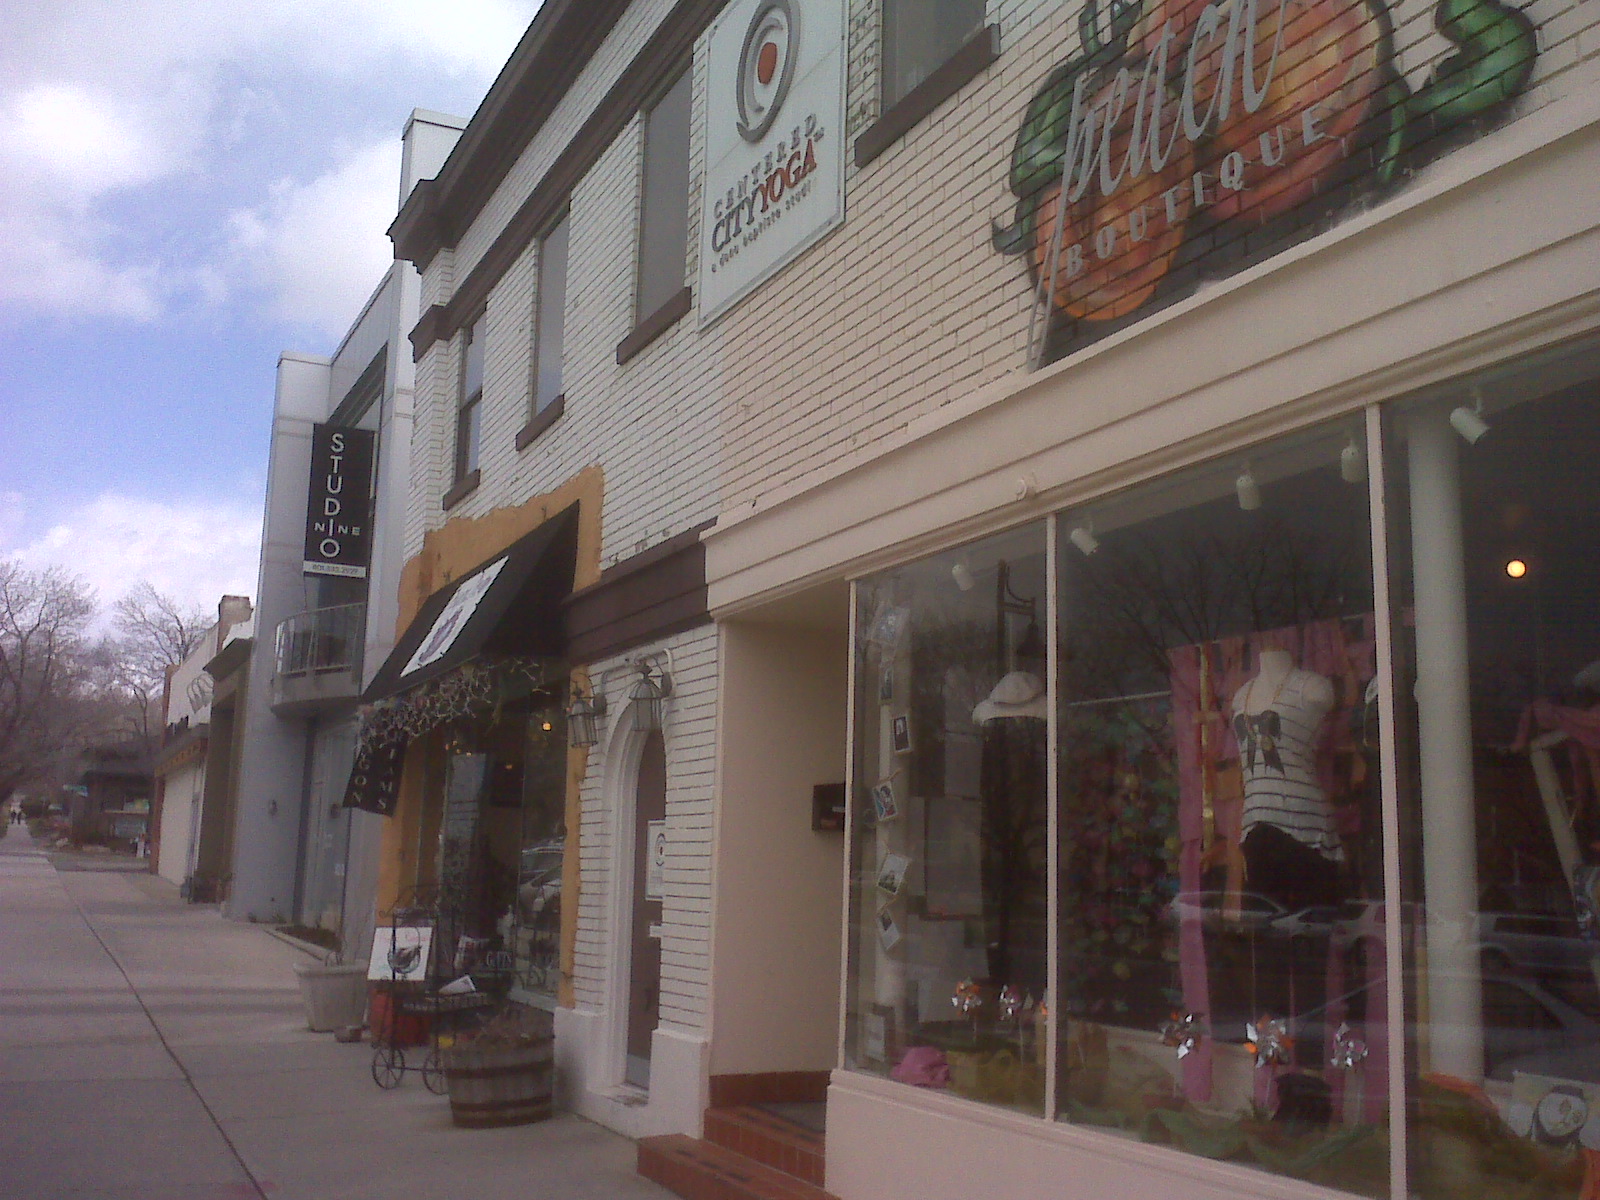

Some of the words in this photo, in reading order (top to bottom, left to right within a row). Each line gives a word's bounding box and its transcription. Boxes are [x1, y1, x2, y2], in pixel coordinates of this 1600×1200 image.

[713, 113, 817, 219] CENTERED
[1066, 105, 1328, 280] BOUTIQUE
[319, 433, 345, 558] STUDIO
